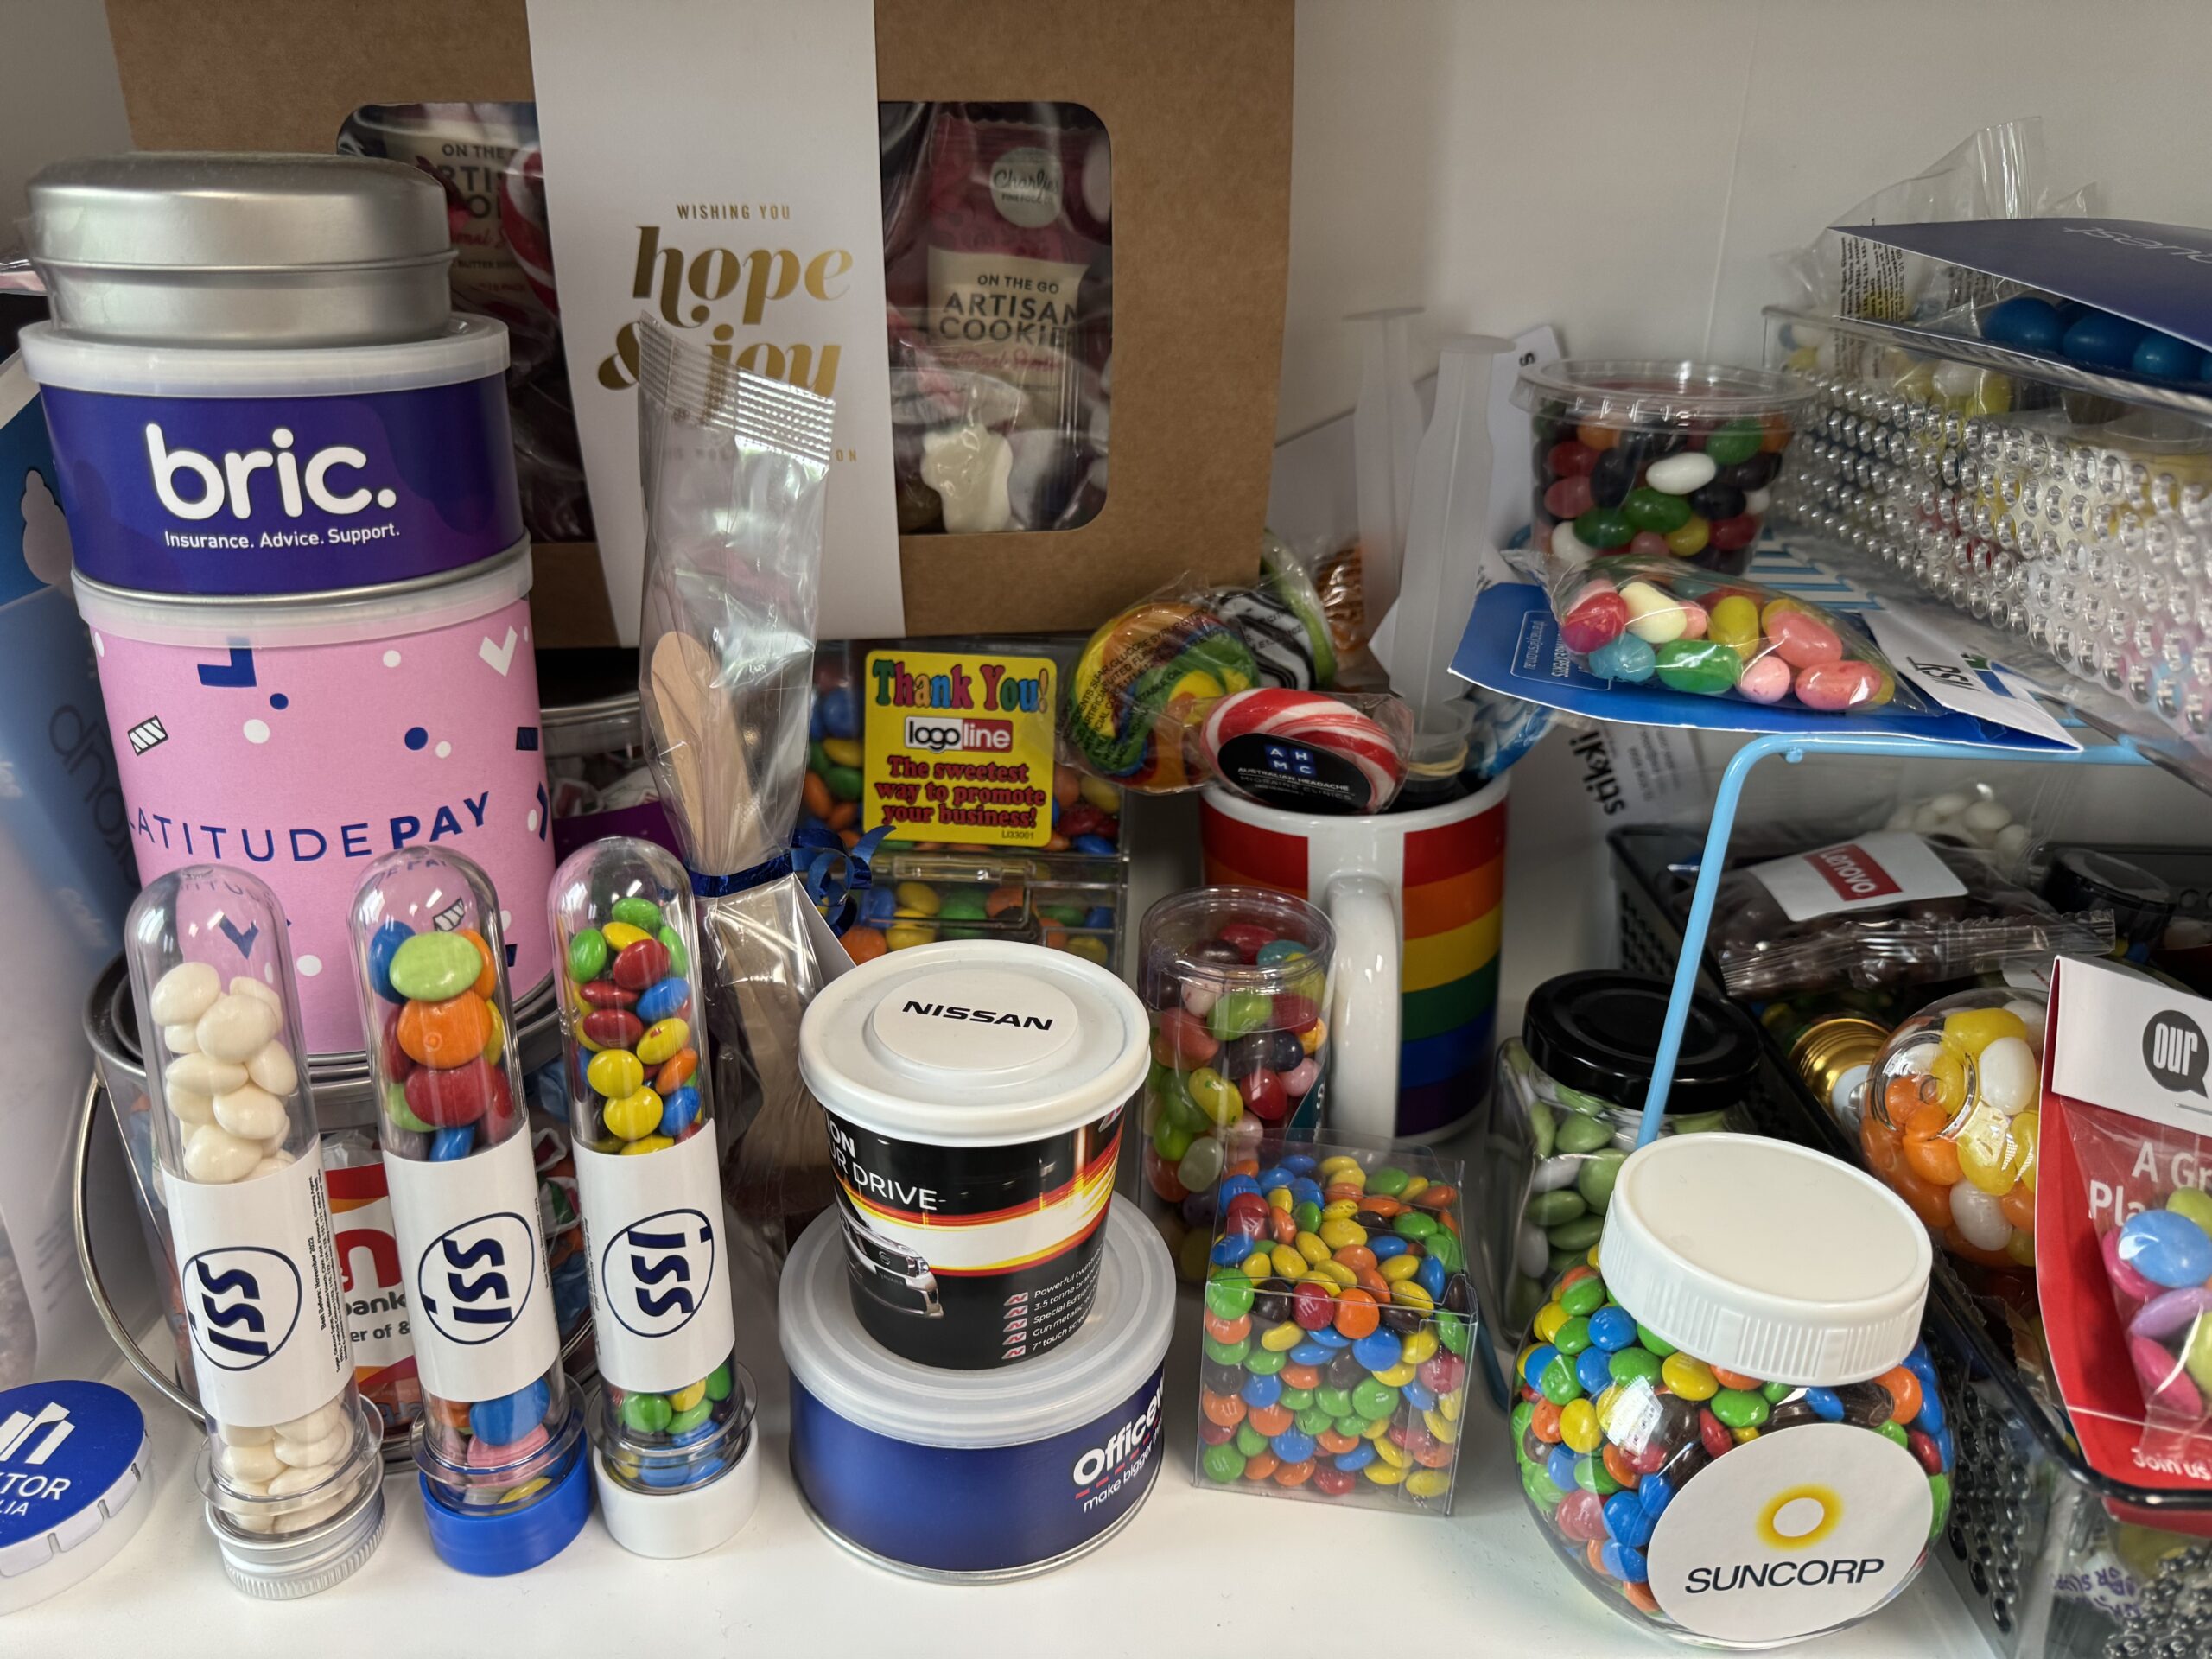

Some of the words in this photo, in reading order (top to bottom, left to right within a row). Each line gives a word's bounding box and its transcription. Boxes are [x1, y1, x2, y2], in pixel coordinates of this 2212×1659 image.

[442, 143, 467, 156] ON
[677, 203, 750, 219] WISHING
[759, 203, 791, 220] YOU
[632, 226, 854, 328] hope
[977, 274, 999, 286] ON
[1004, 276, 1033, 290] THE
[1037, 281, 1059, 295] GO
[943, 291, 1078, 326] ARTISAN
[146, 423, 397, 520] bric.
[165, 531, 254, 549] Insurance.
[260, 531, 324, 548] Advice.
[327, 522, 400, 545] Support.
[873, 659, 975, 710] Thank
[979, 664, 1050, 715] You!
[887, 754, 931, 778] The
[933, 761, 1031, 784] sweetest
[874, 781, 922, 804] way
[925, 781, 950, 802] to
[952, 786, 1047, 808] promote
[880, 804, 935, 826] your
[938, 804, 1038, 829] business!
[1819, 847, 1877, 894] Lenovo
[902, 1001, 1053, 1031] NISSAN
[2131, 1141, 2158, 1183] A
[1033, 1300, 1049, 1311] 3.5
[1049, 1286, 1075, 1304] tonne
[1034, 1273, 1075, 1299] Powerful
[1033, 1303, 1065, 1324] Special
[372, 1324, 393, 1338] of
[1033, 1321, 1052, 1337] Gun
[1042, 1328, 1068, 1347] touch
[1084, 1477, 1122, 1513] make
[1122, 1440, 1153, 1485] bigger
[2130, 1447, 2183, 1476] Join
[2182, 1459, 2212, 1481] us
[1685, 1558, 1885, 1594] SUNCORP
